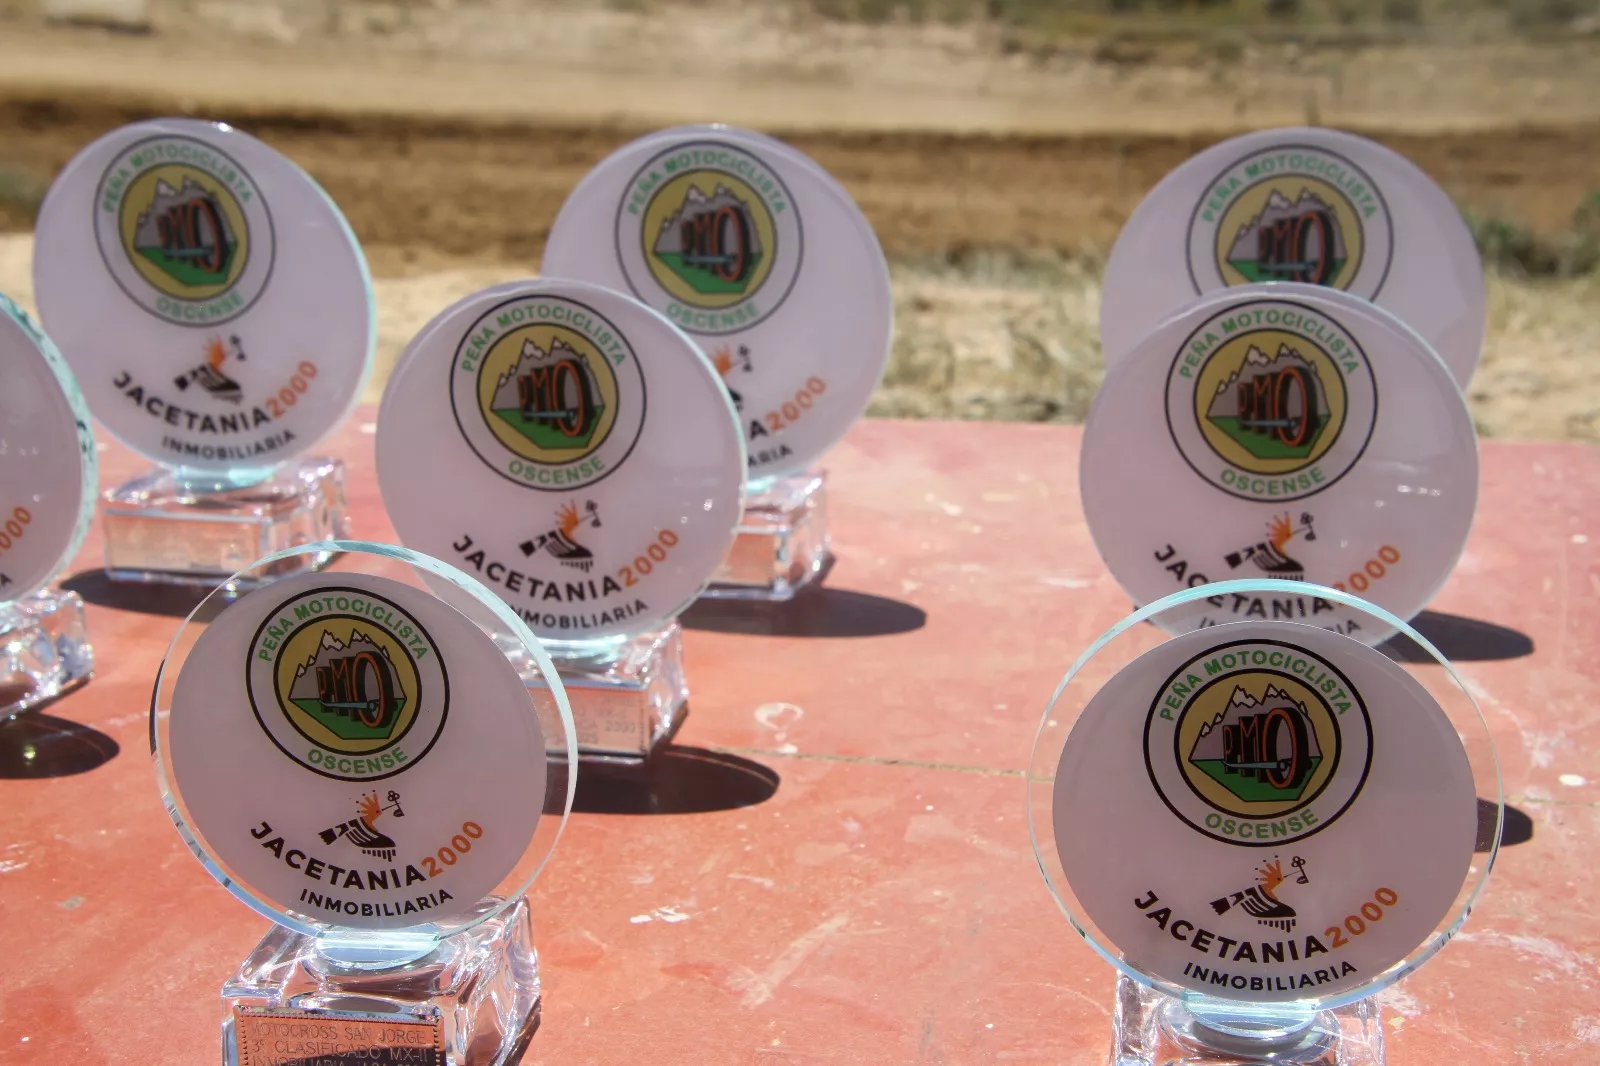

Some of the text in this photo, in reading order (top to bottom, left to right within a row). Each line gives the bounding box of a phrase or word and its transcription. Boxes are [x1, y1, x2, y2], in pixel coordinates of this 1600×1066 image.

[131, 144, 253, 202] MOTOCICLISTA
[664, 150, 786, 214] MOTOCICLISTA
[1245, 155, 1377, 219] MOTOCICLISTA
[156, 292, 243, 319] OSCENSE
[666, 300, 760, 329] OSCENSE
[462, 304, 626, 373] PEÑA MOTOCICLISTA
[1179, 310, 1359, 379] PEÑA MOTOCICLISTA
[162, 429, 296, 461] INMOBILIARIA
[508, 456, 606, 484] OSCENSE
[1220, 466, 1326, 495] OSCENSE
[510, 599, 649, 629] NMOBILIARIA
[258, 597, 428, 662] PEÑA MOTOCICLISTA
[1160, 650, 1351, 721] PEÑA MOTOCICLISTA
[307, 746, 408, 774] OSCENSE
[1205, 808, 1319, 839] OSCENSE
[300, 888, 454, 917] INMOBILIARIA
[1183, 961, 1358, 991] INMOBILIARIA
[275, 1040, 382, 1059] CLASIFICADO
[344, 1026, 372, 1041] SAN
[379, 1029, 425, 1045] JORGE
